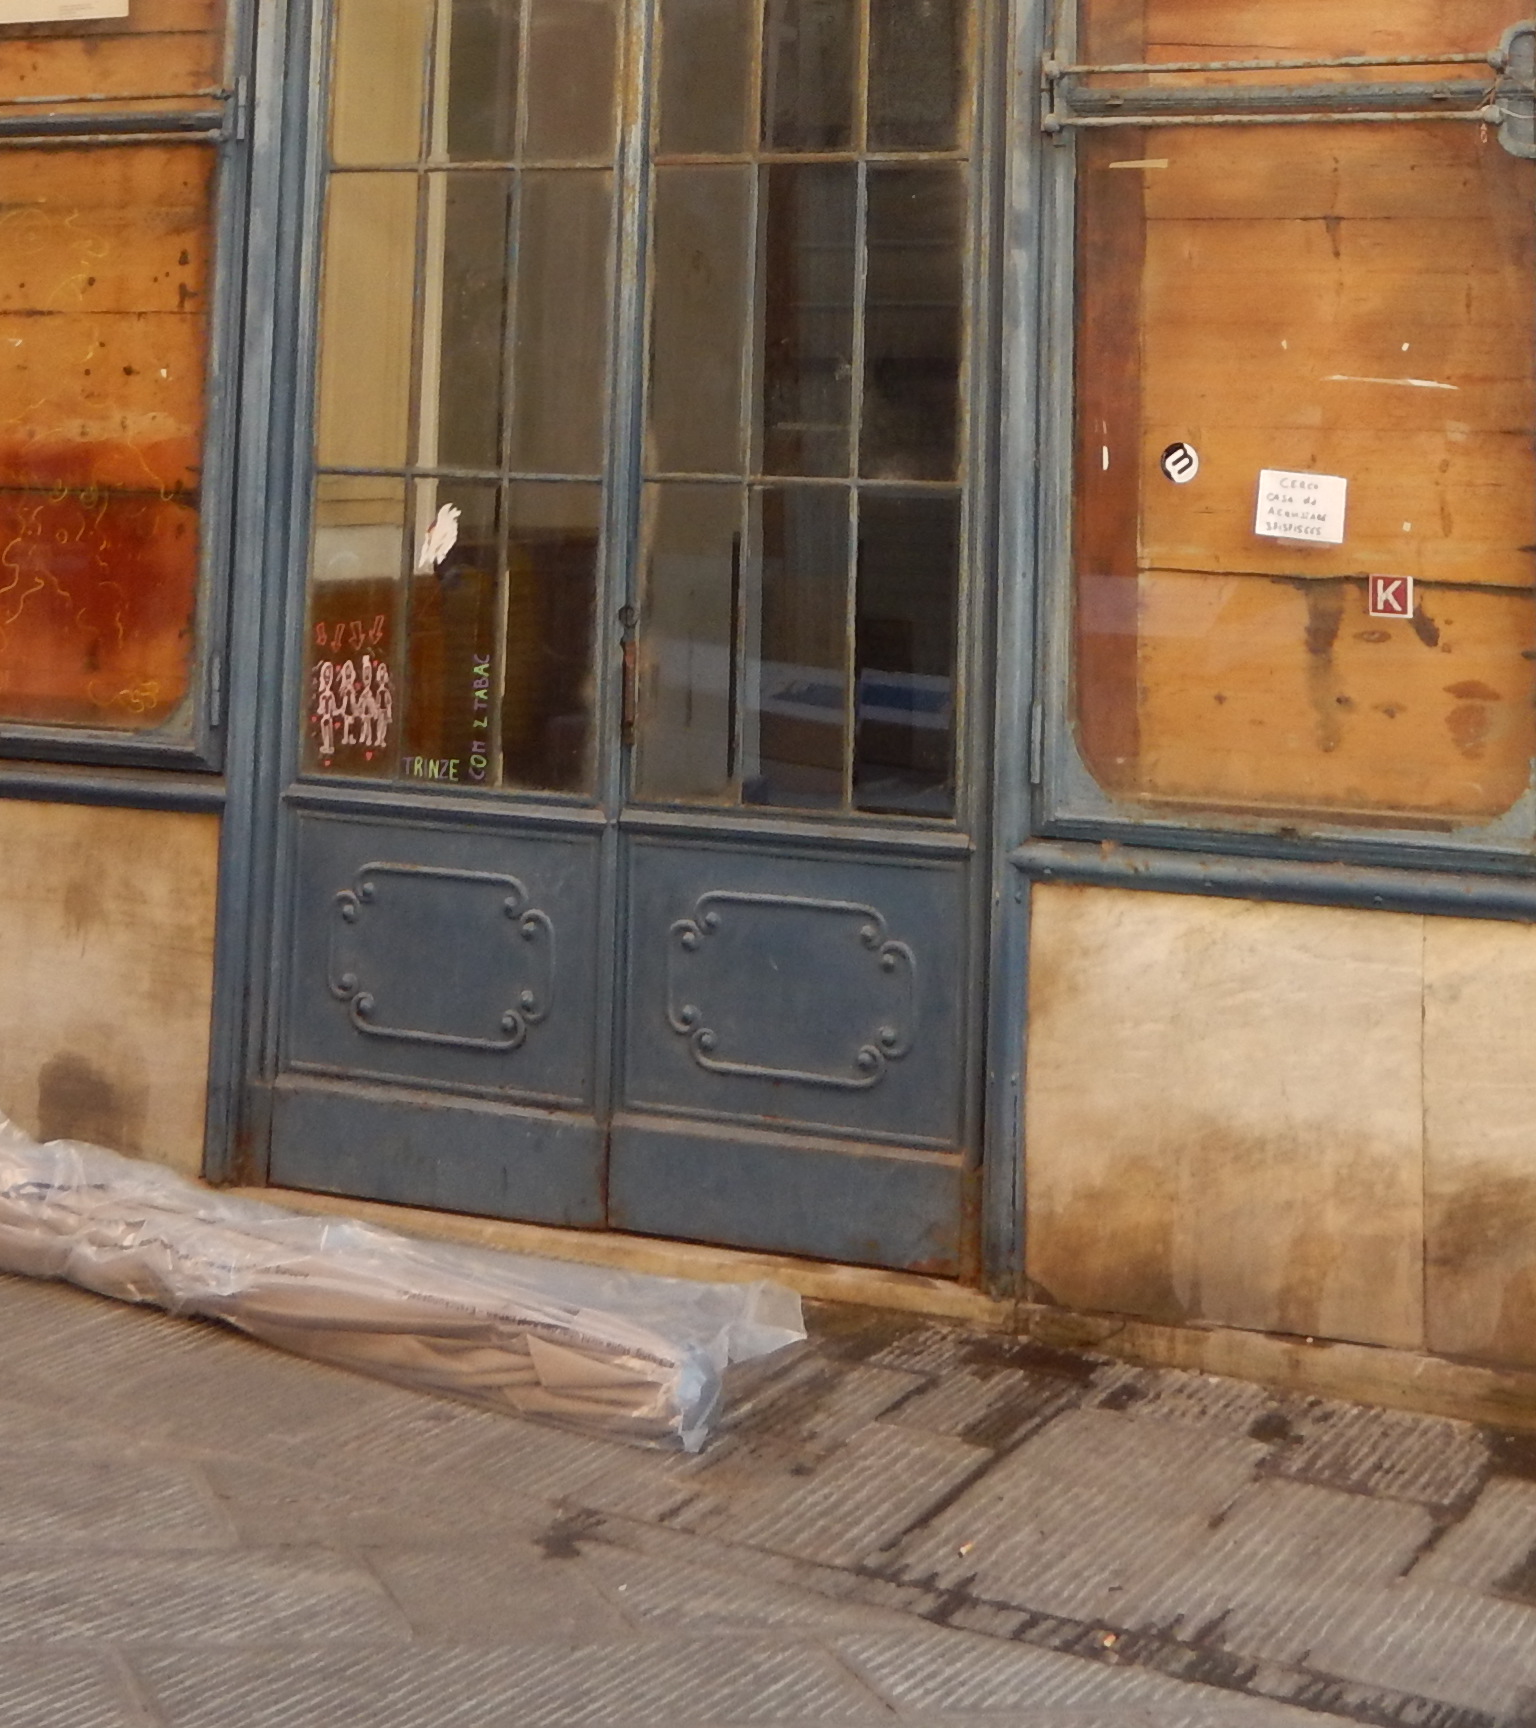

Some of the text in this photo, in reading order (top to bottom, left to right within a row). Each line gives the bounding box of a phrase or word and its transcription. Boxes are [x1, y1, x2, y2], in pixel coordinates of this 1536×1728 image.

[1376, 578, 1402, 612] K
[473, 653, 490, 711] TABAC
[403, 755, 460, 782] TRINZE
